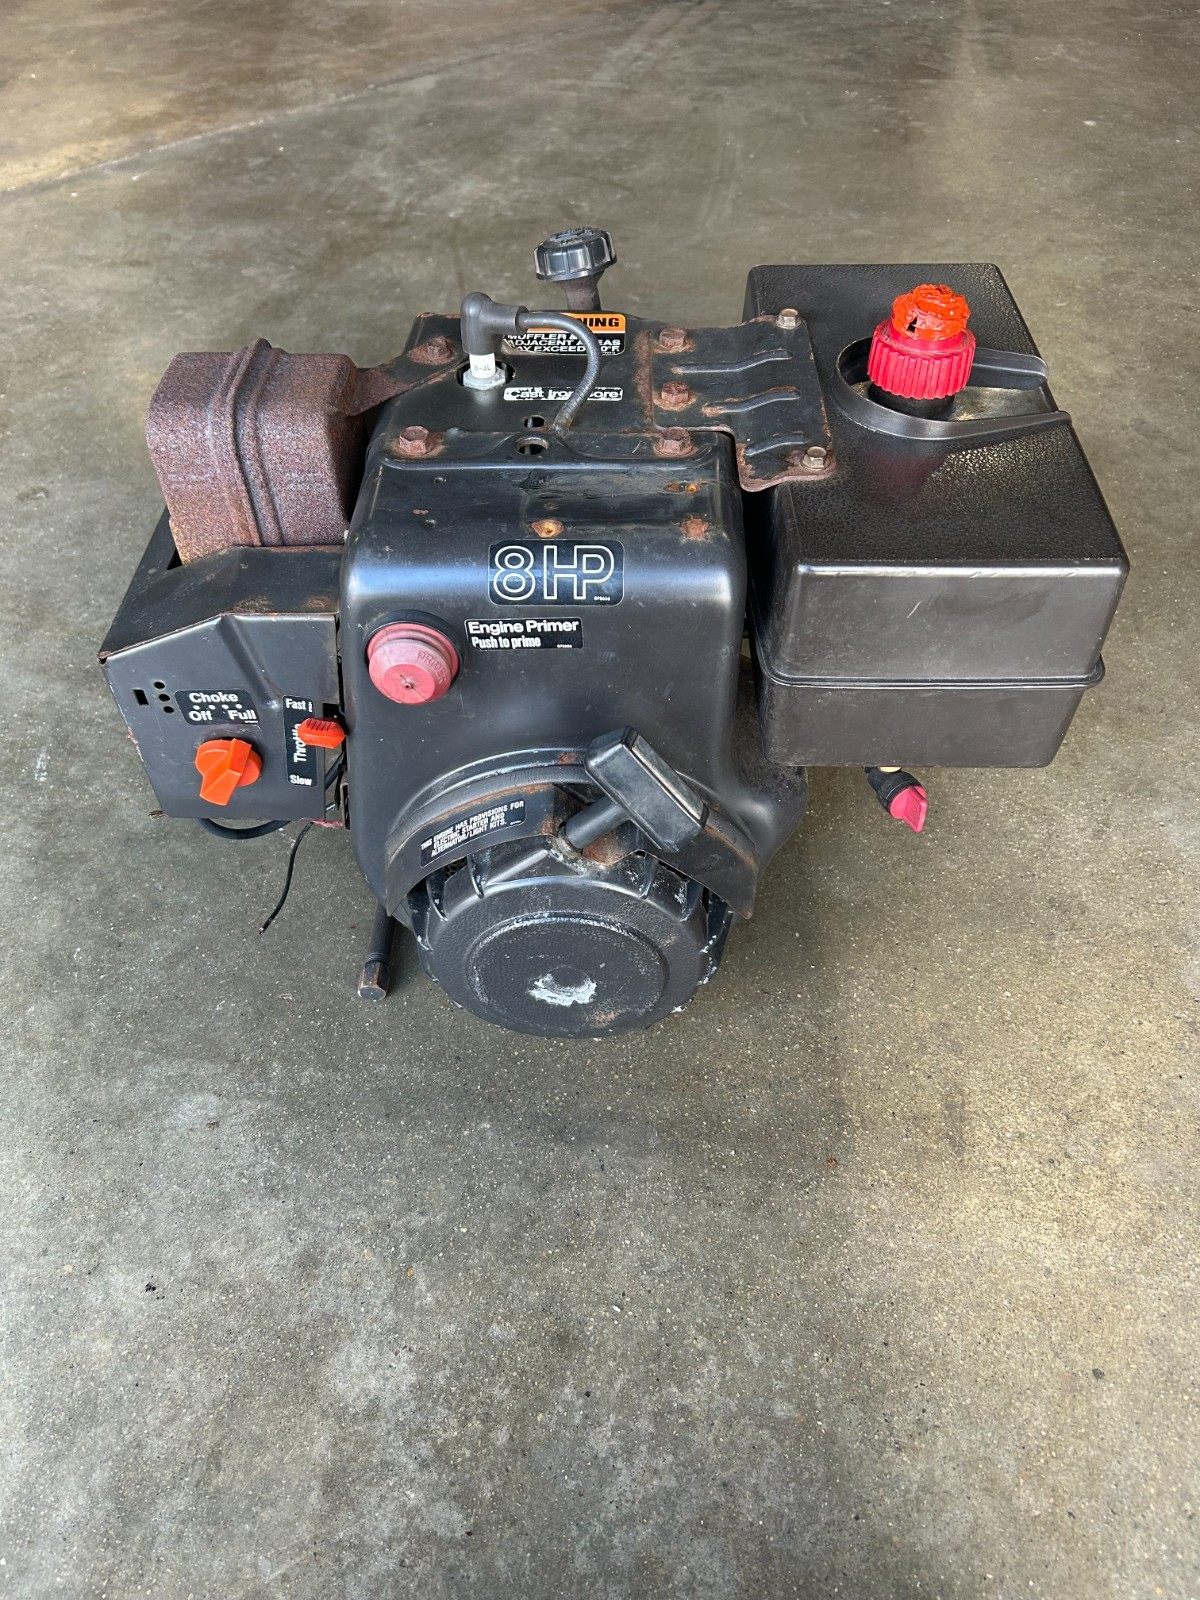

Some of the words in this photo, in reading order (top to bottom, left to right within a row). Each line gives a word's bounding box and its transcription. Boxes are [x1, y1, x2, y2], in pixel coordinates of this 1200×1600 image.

[508, 388, 544, 398] Cast
[589, 389, 619, 398] ore
[467, 621, 523, 636] Engine
[525, 620, 580, 633] Primer
[471, 636, 498, 649] Push
[499, 636, 510, 649] to
[511, 635, 542, 649] prime
[188, 691, 239, 703] Choke
[285, 698, 307, 710] Fast
[188, 709, 213, 722] Off
[227, 709, 257, 721] Full
[289, 774, 313, 786] Slow
[421, 838, 433, 851] THIS
[433, 826, 454, 843] ENGINE
[455, 819, 468, 831] HAS
[470, 804, 508, 825] PROVISIONS
[510, 800, 525, 810] FOR
[489, 818, 507, 830] KITS.
[433, 828, 460, 849] ELECTRIC
[461, 817, 489, 834] STARTER
[490, 812, 505, 823] AND
